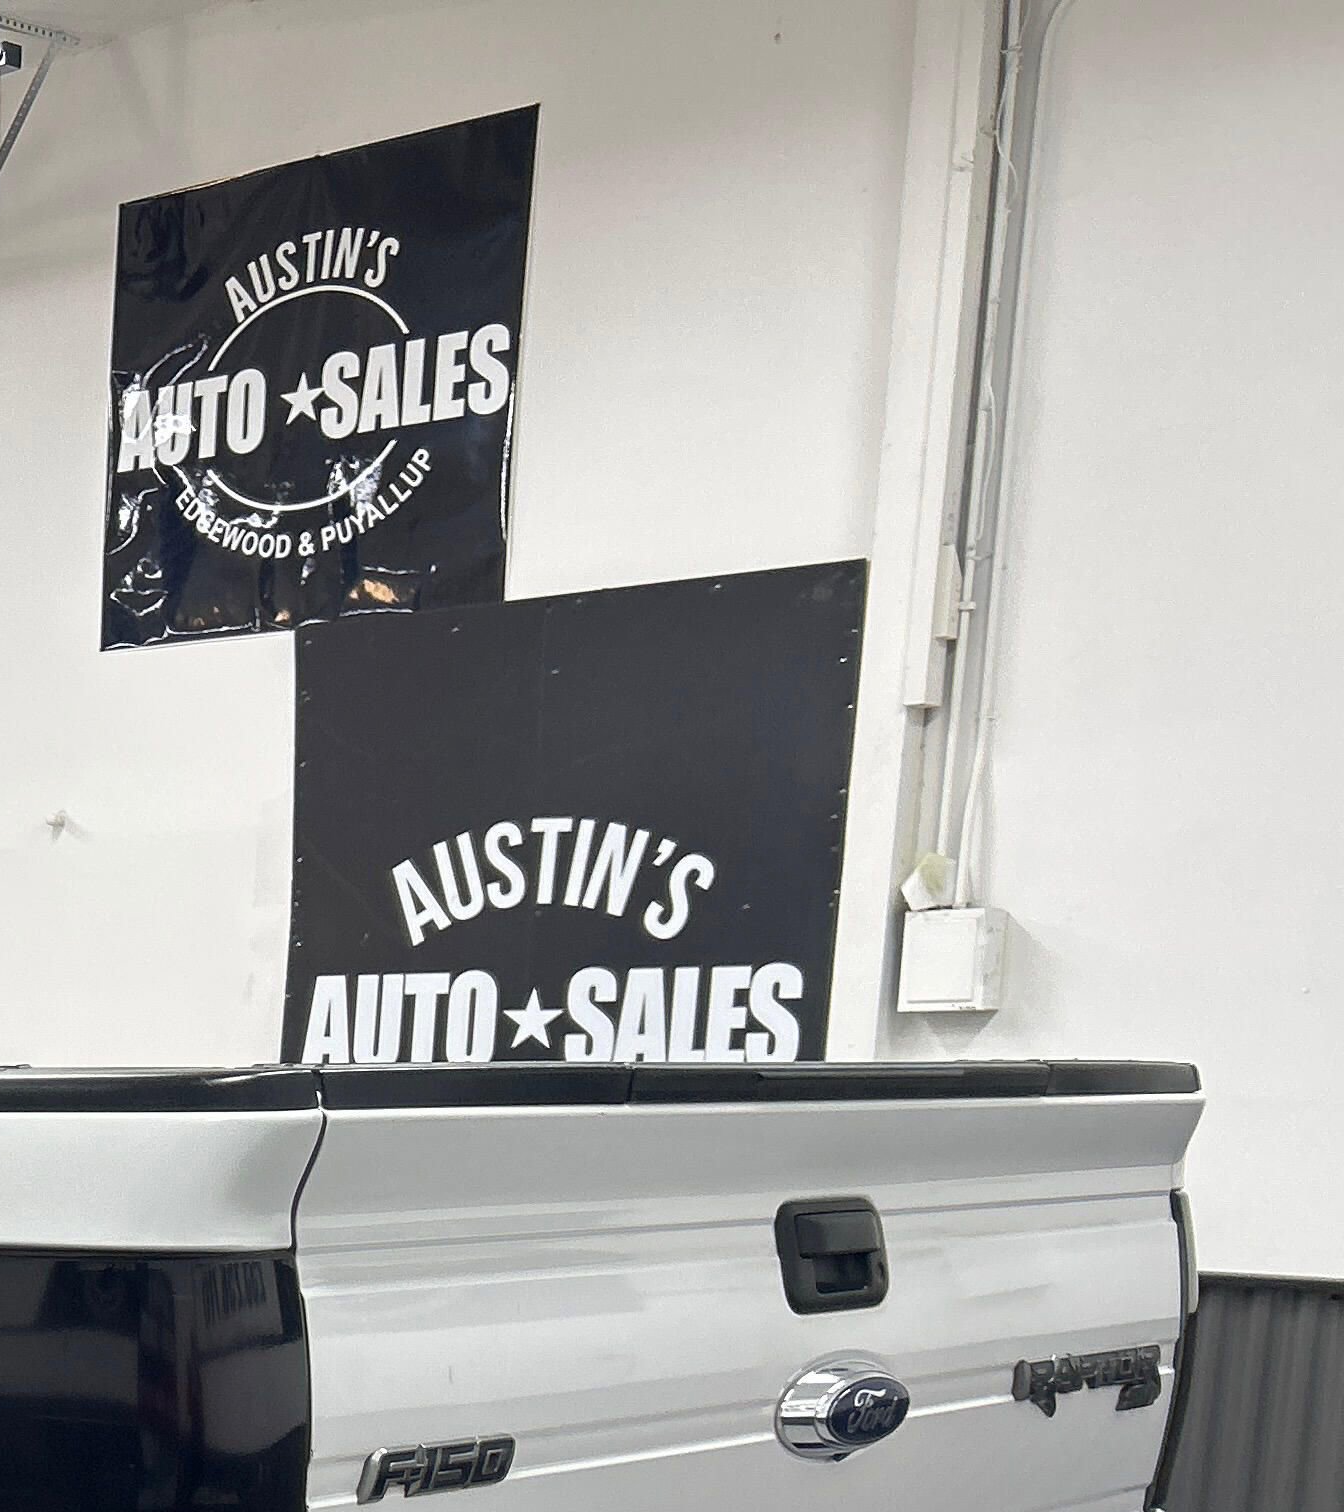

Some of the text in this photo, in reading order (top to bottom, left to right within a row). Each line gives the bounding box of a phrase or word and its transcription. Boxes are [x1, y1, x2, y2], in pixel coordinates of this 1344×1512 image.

[223, 226, 400, 323] AUSTIN'S
[116, 322, 512, 473] AUTO SALES
[174, 448, 434, 559] EDGEWOOD & PUYALLUP
[391, 817, 714, 947] AUSTIN'S
[301, 963, 804, 1063] AUTO SALES
